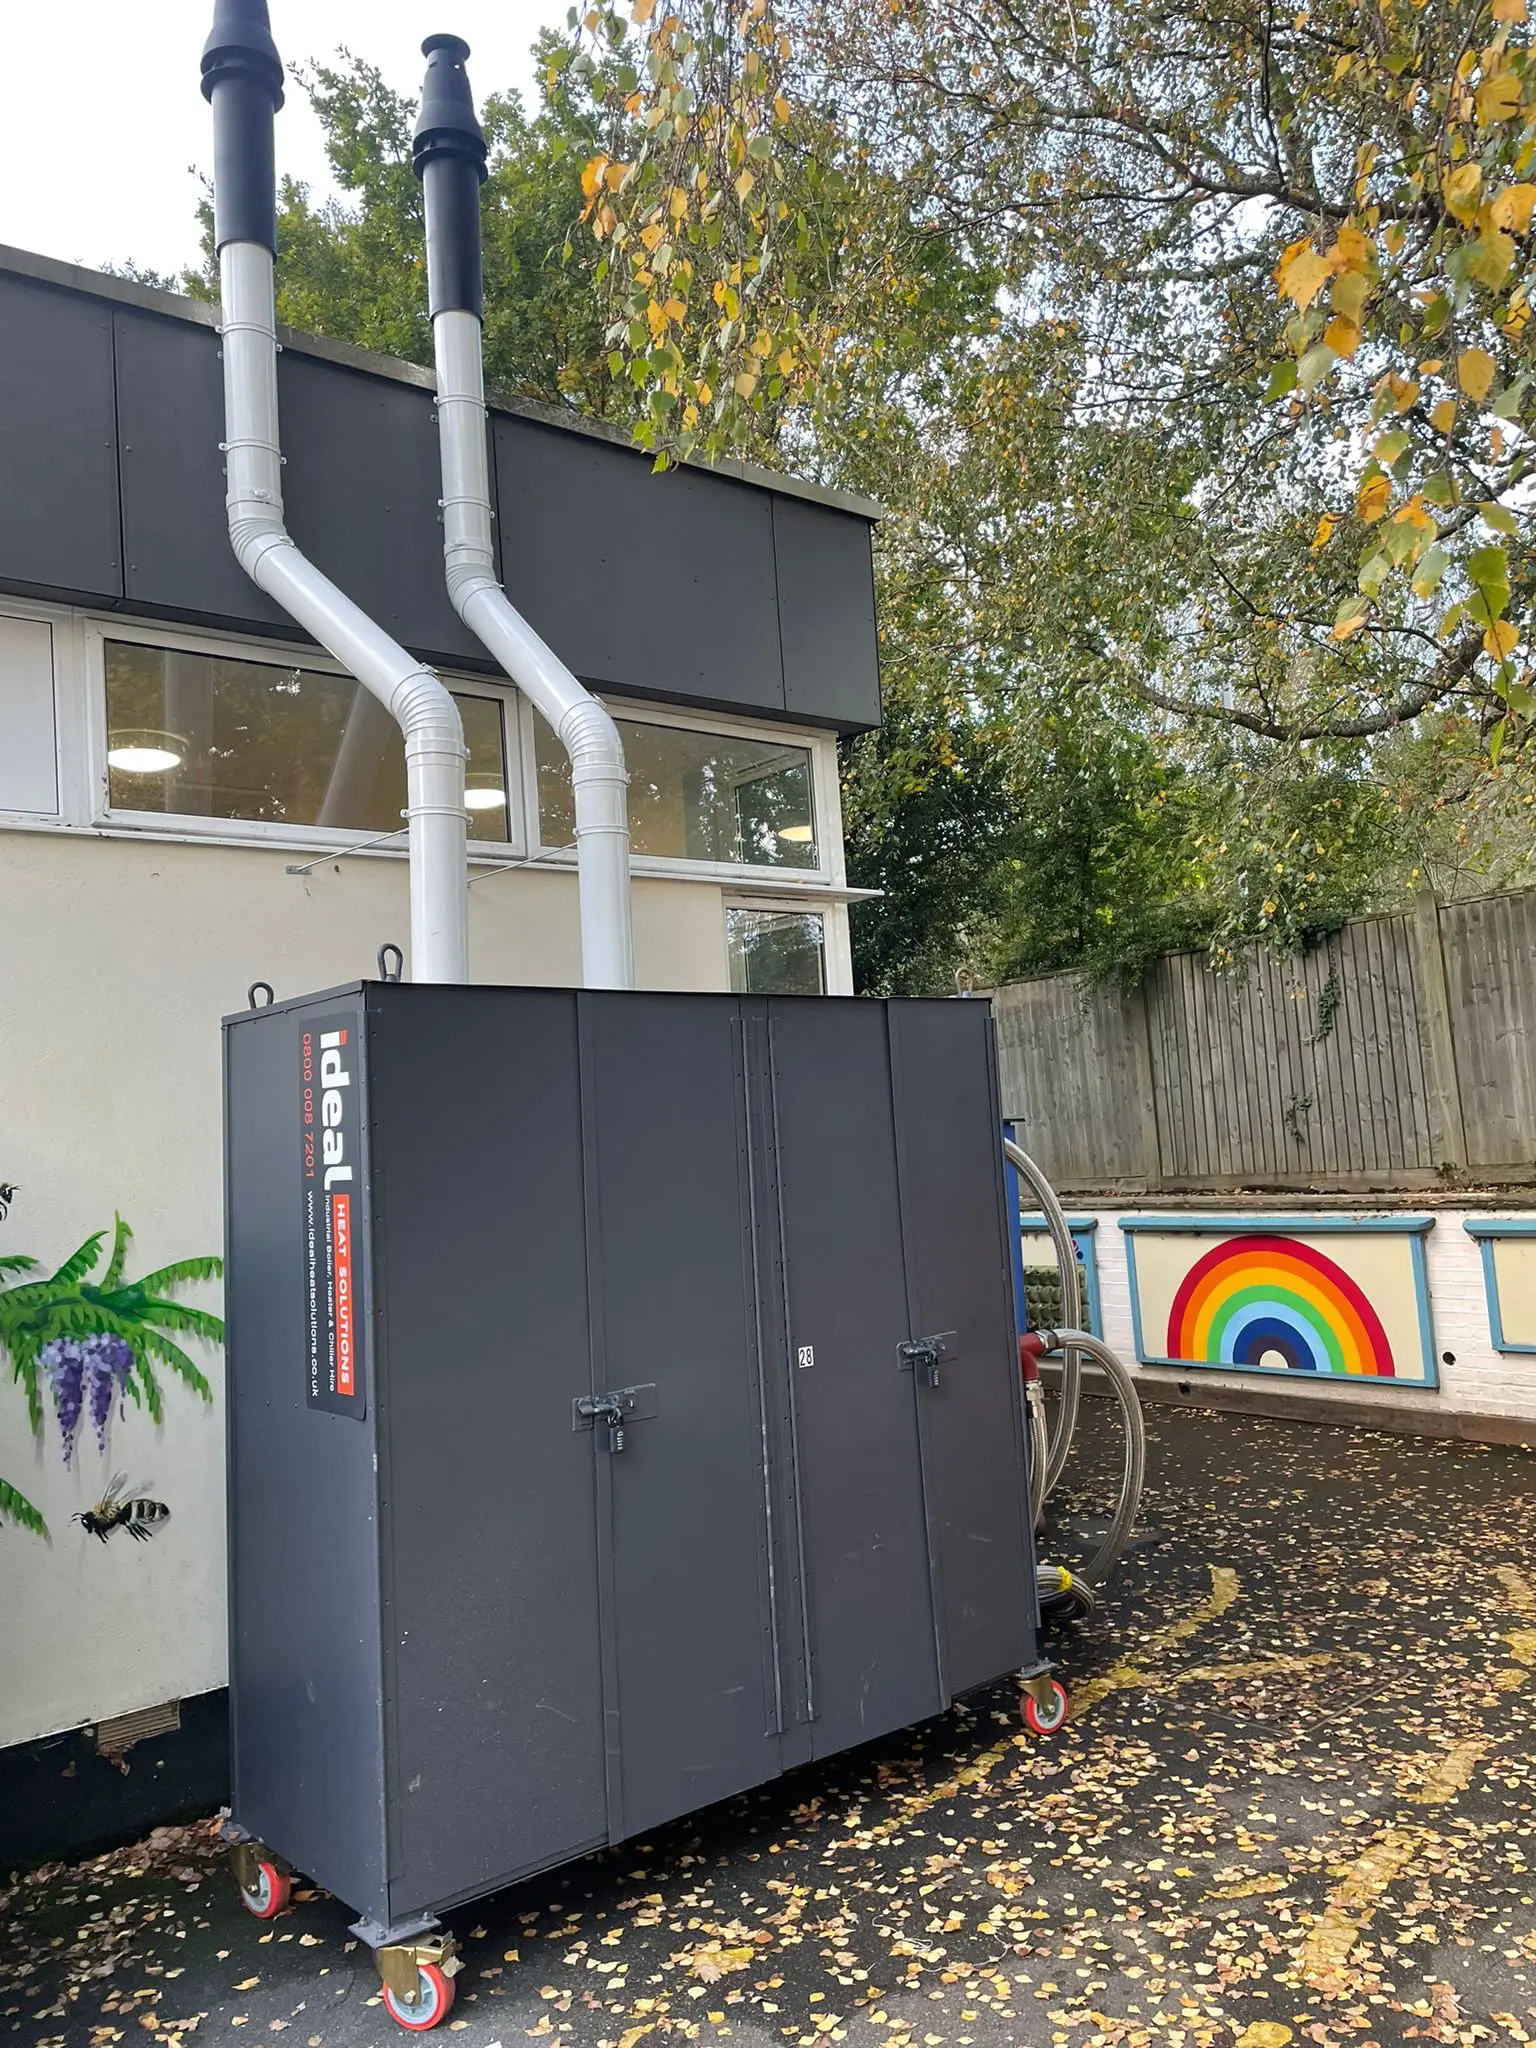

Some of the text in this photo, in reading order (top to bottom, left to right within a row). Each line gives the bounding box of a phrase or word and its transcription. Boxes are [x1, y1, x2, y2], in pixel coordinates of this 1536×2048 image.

[303, 1033, 315, 1177] 0800 008 7201
[320, 1029, 353, 1190] ideal
[307, 1190, 319, 1397] www.idealheatsolutions.co.uk
[328, 1319, 334, 1328] &
[337, 1203, 350, 1384] HEAT SOLUTIONS
[800, 1348, 812, 1366] 28
